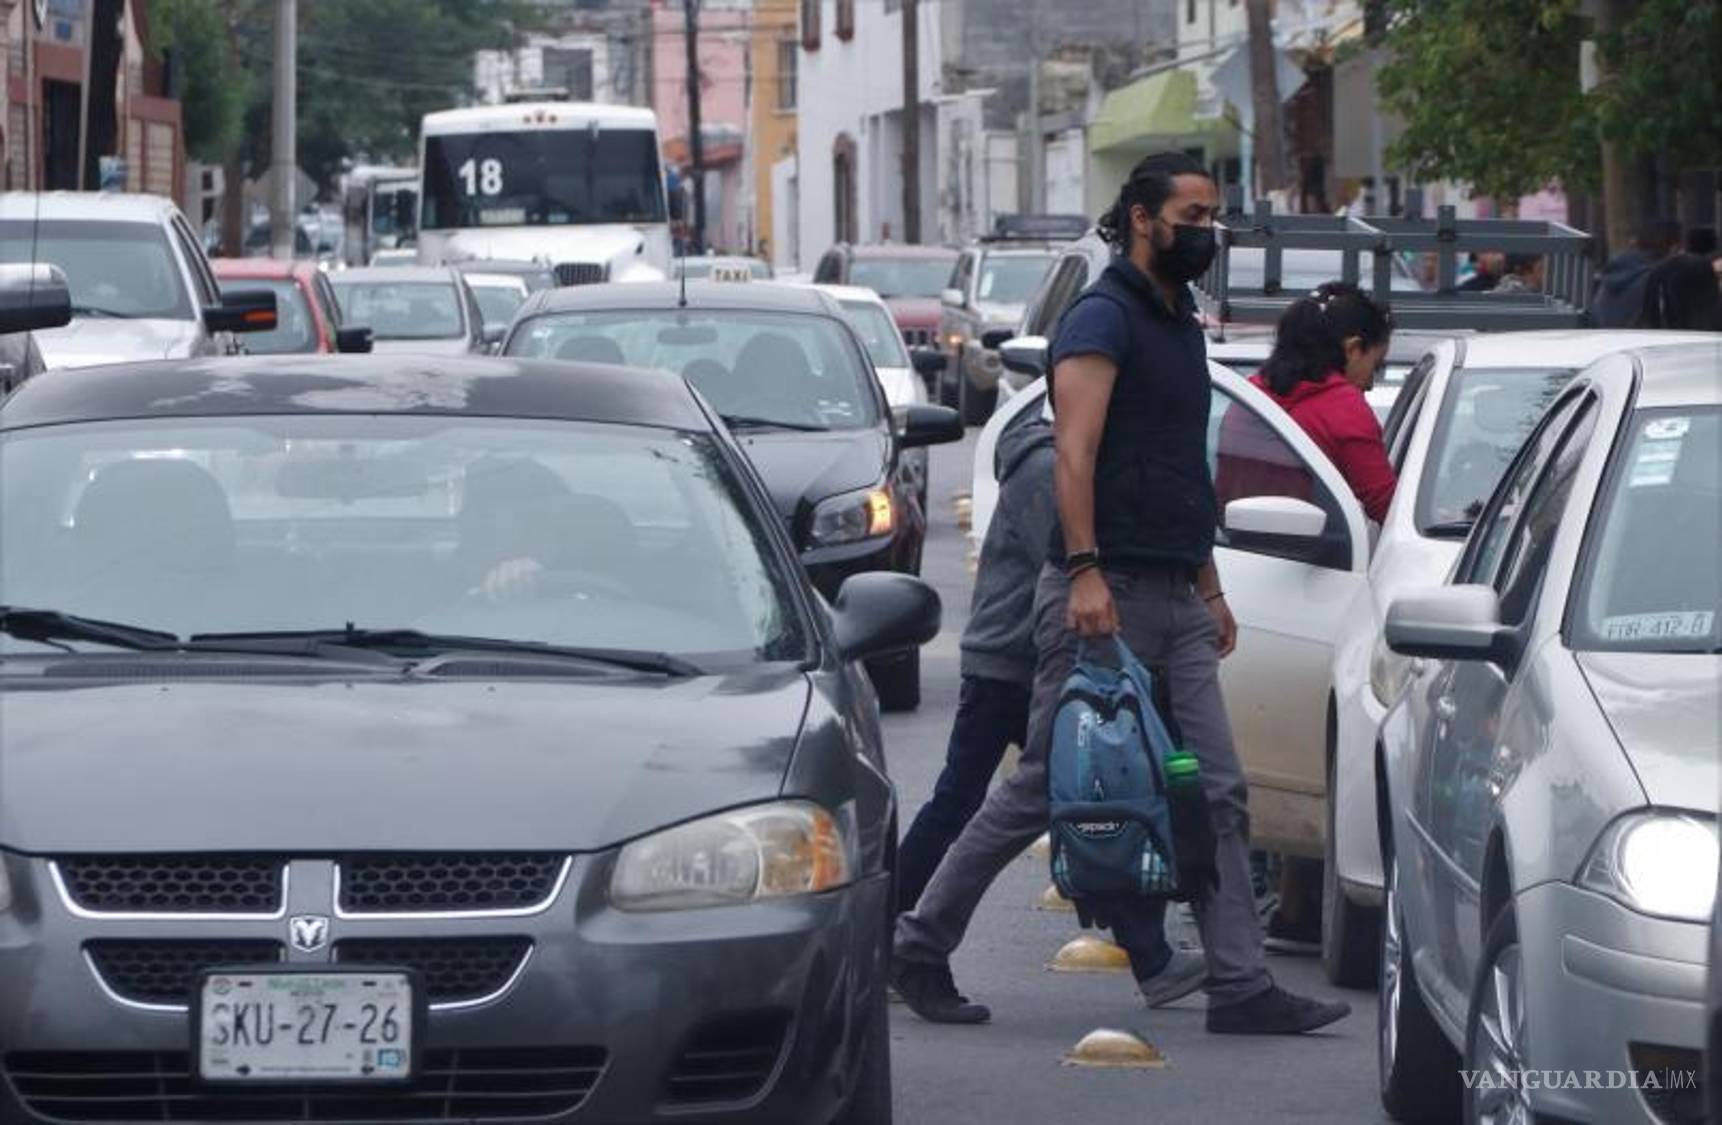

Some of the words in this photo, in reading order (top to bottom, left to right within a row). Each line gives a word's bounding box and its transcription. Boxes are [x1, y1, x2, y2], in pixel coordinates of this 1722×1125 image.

[458, 158, 503, 196] 18
[714, 267, 750, 284] TAXI
[211, 1002, 399, 1046] SKU-27-26
